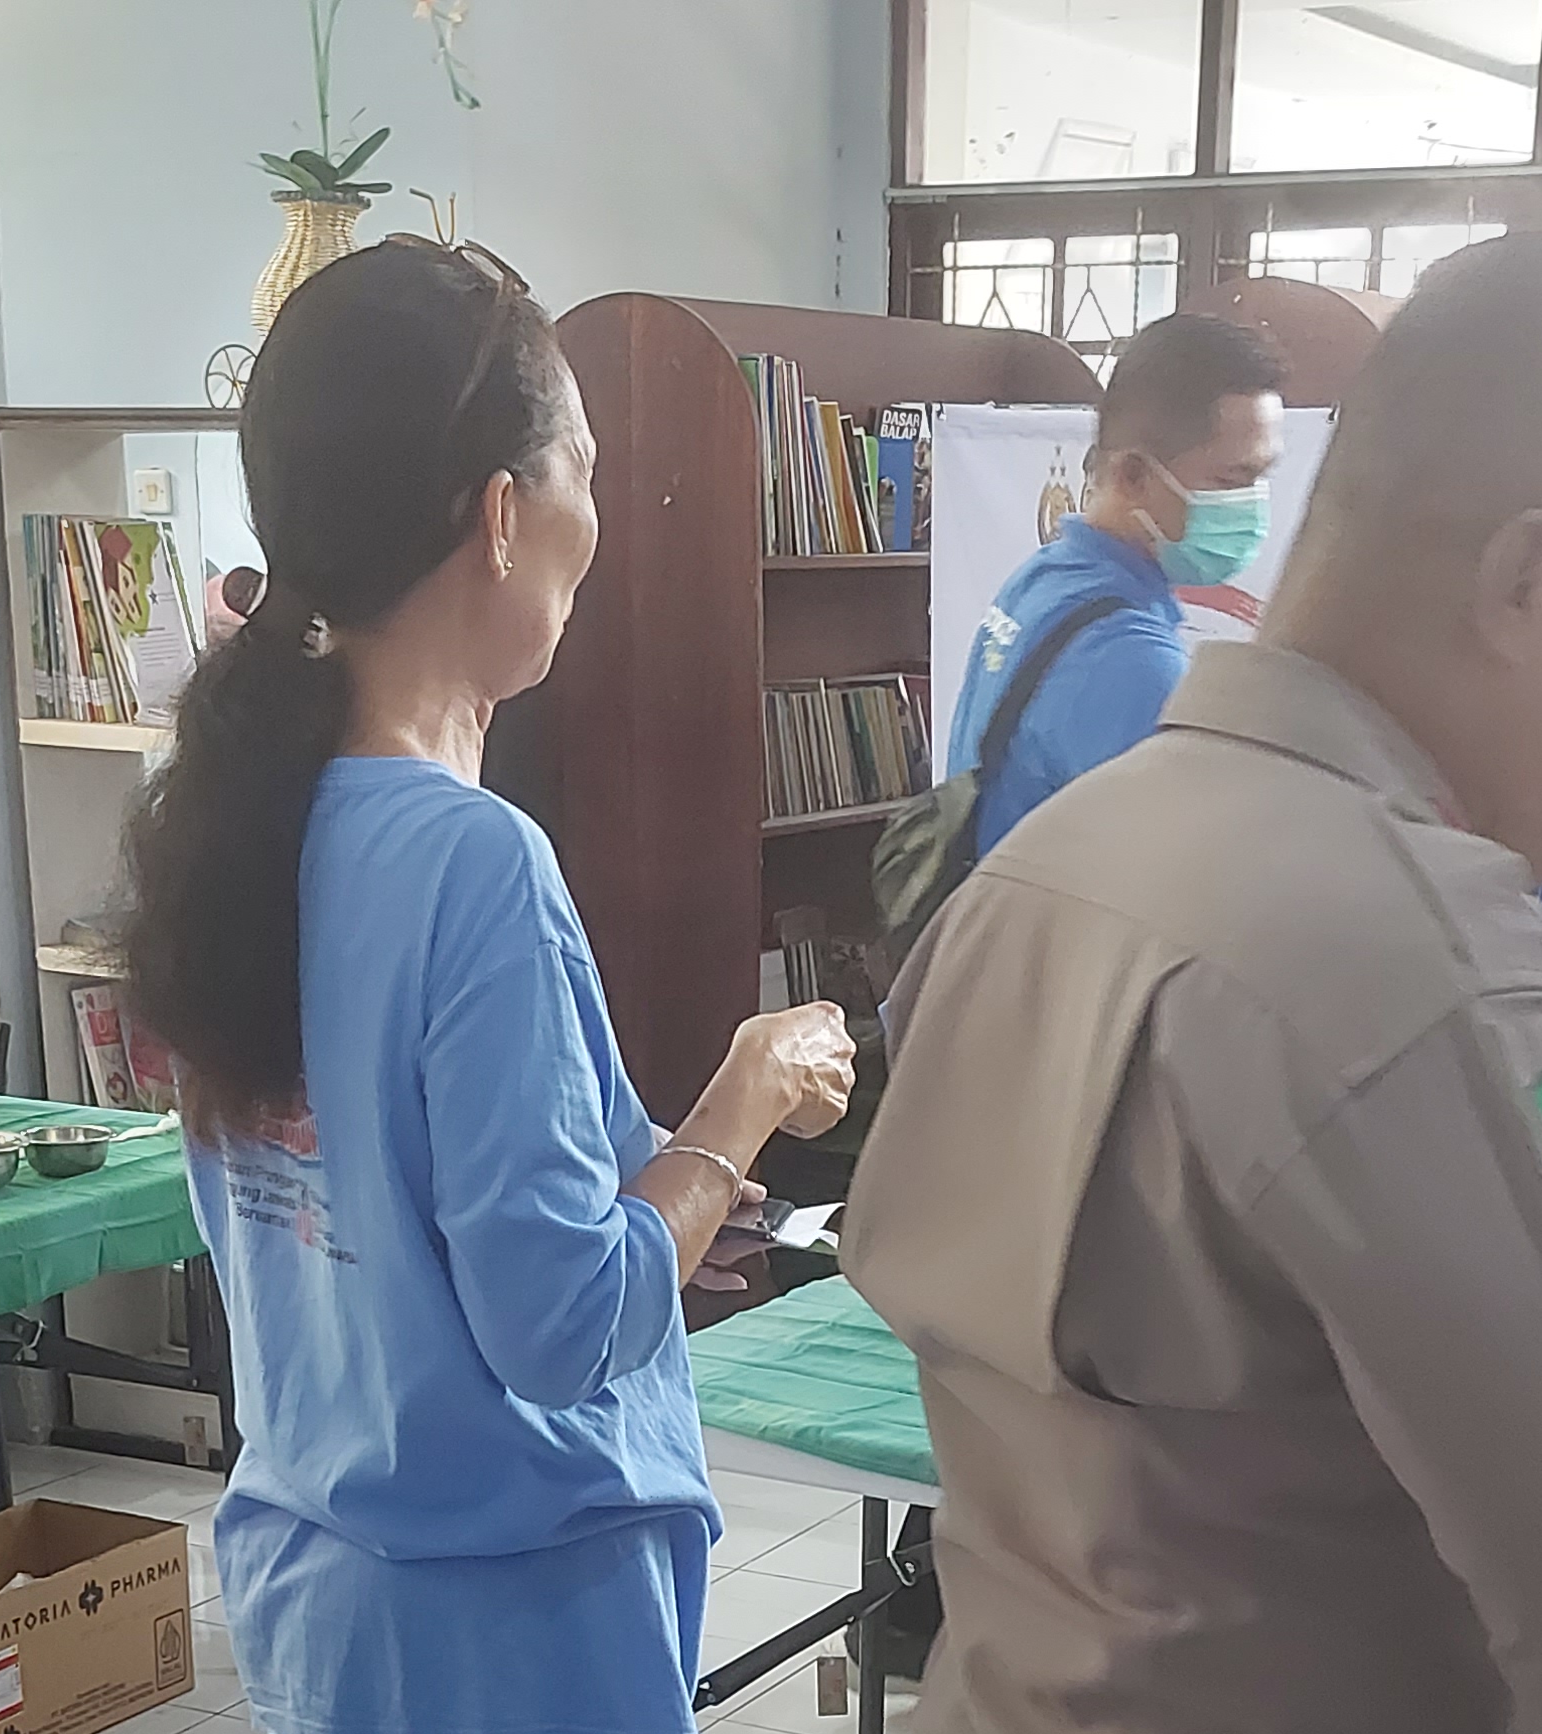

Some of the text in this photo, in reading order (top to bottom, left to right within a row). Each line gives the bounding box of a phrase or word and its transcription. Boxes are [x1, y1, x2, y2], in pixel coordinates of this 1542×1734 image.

[882, 409, 920, 428] DASAR
[880, 423, 918, 440] BALAP
[111, 1557, 181, 1598] PHARMA
